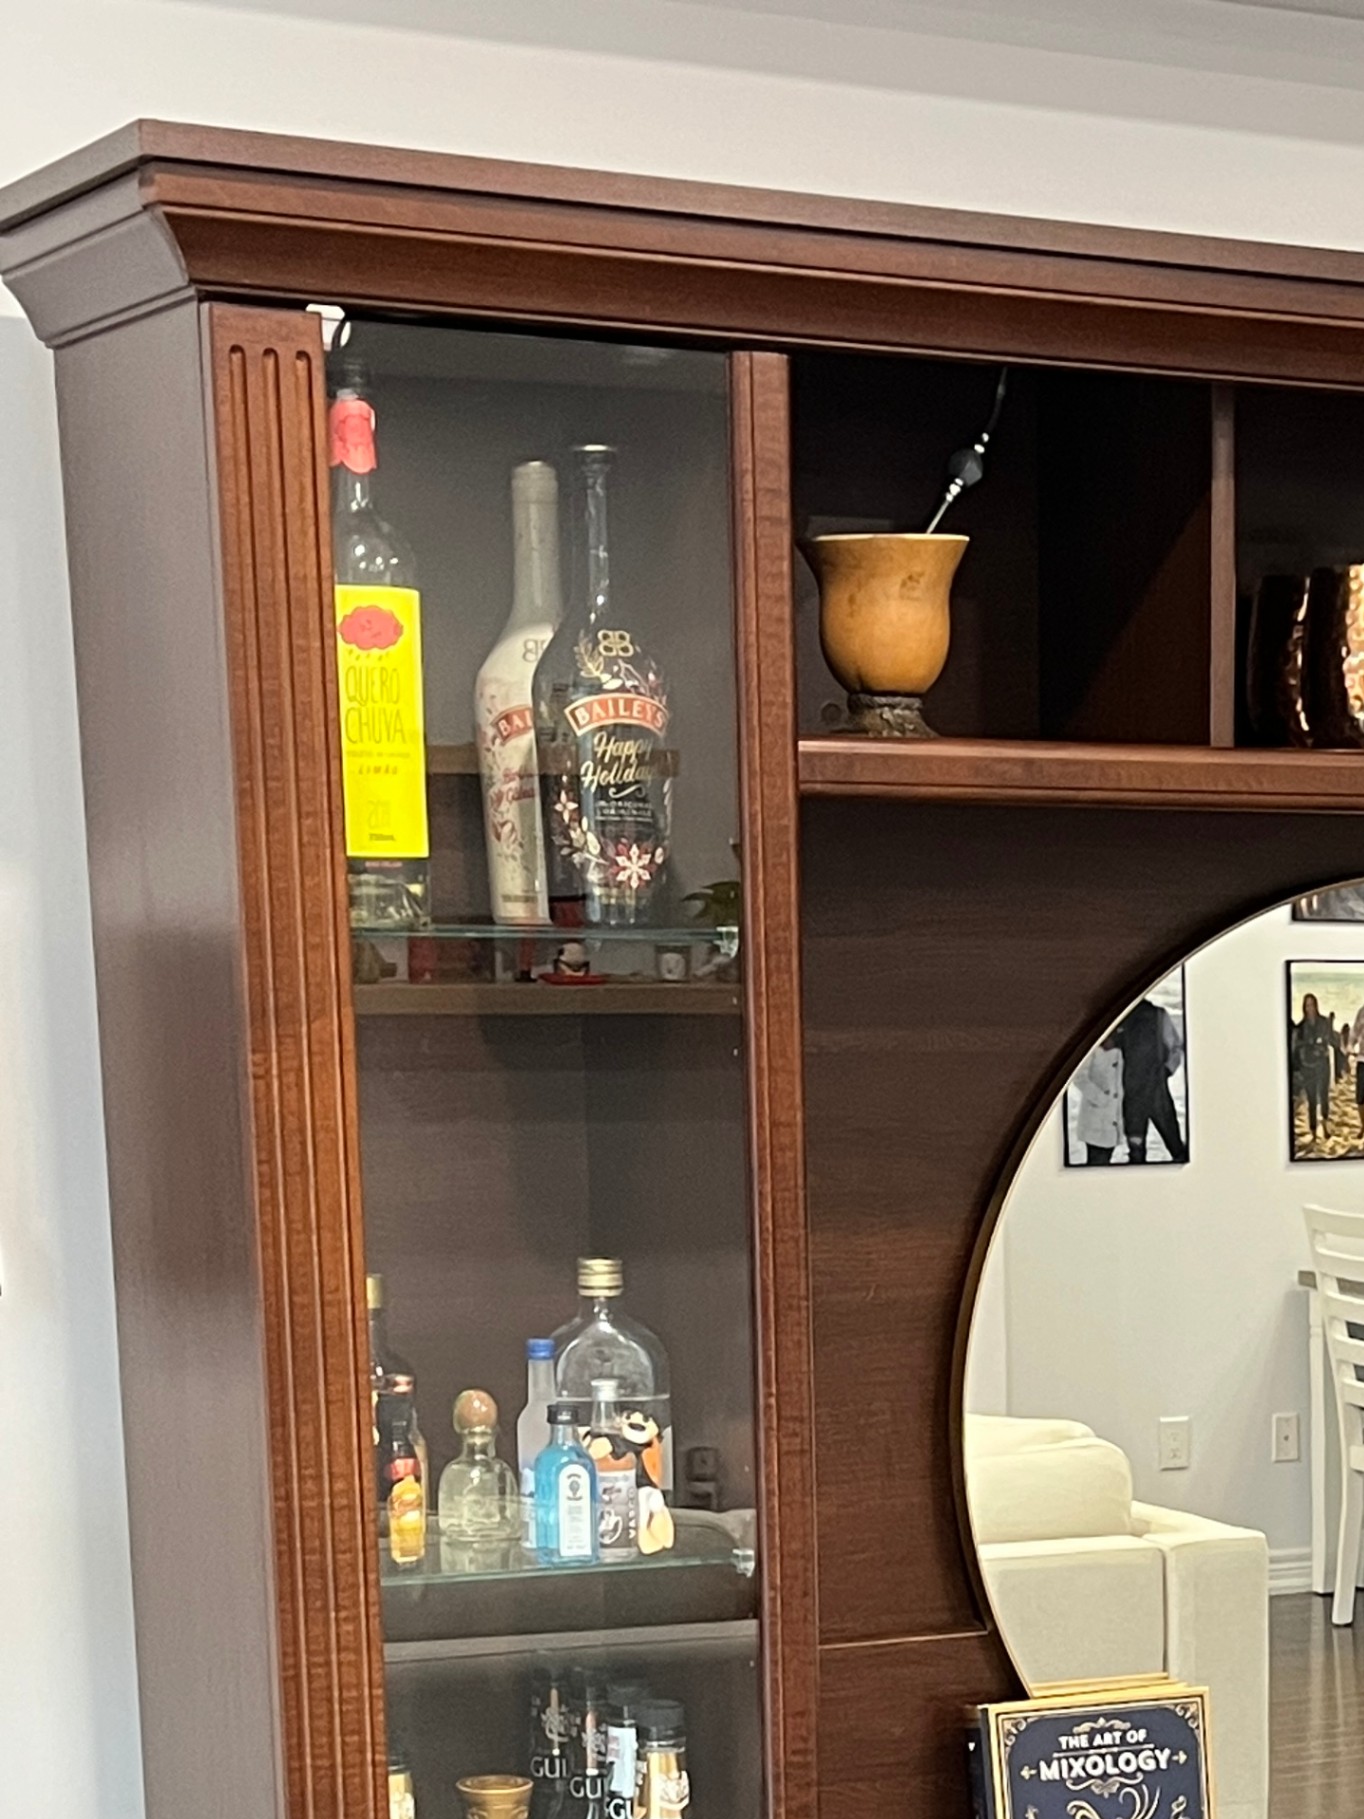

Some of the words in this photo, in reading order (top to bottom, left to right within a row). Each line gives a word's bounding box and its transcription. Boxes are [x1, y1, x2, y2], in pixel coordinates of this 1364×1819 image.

[345, 666, 400, 706] QUERO
[574, 698, 664, 727] BAILEYS
[593, 731, 653, 763] Happy
[1058, 1734, 1089, 1750] THE
[1093, 1731, 1122, 1747] ART
[1126, 1728, 1147, 1744] OF
[1039, 1748, 1171, 1781] MIXOLOGY
